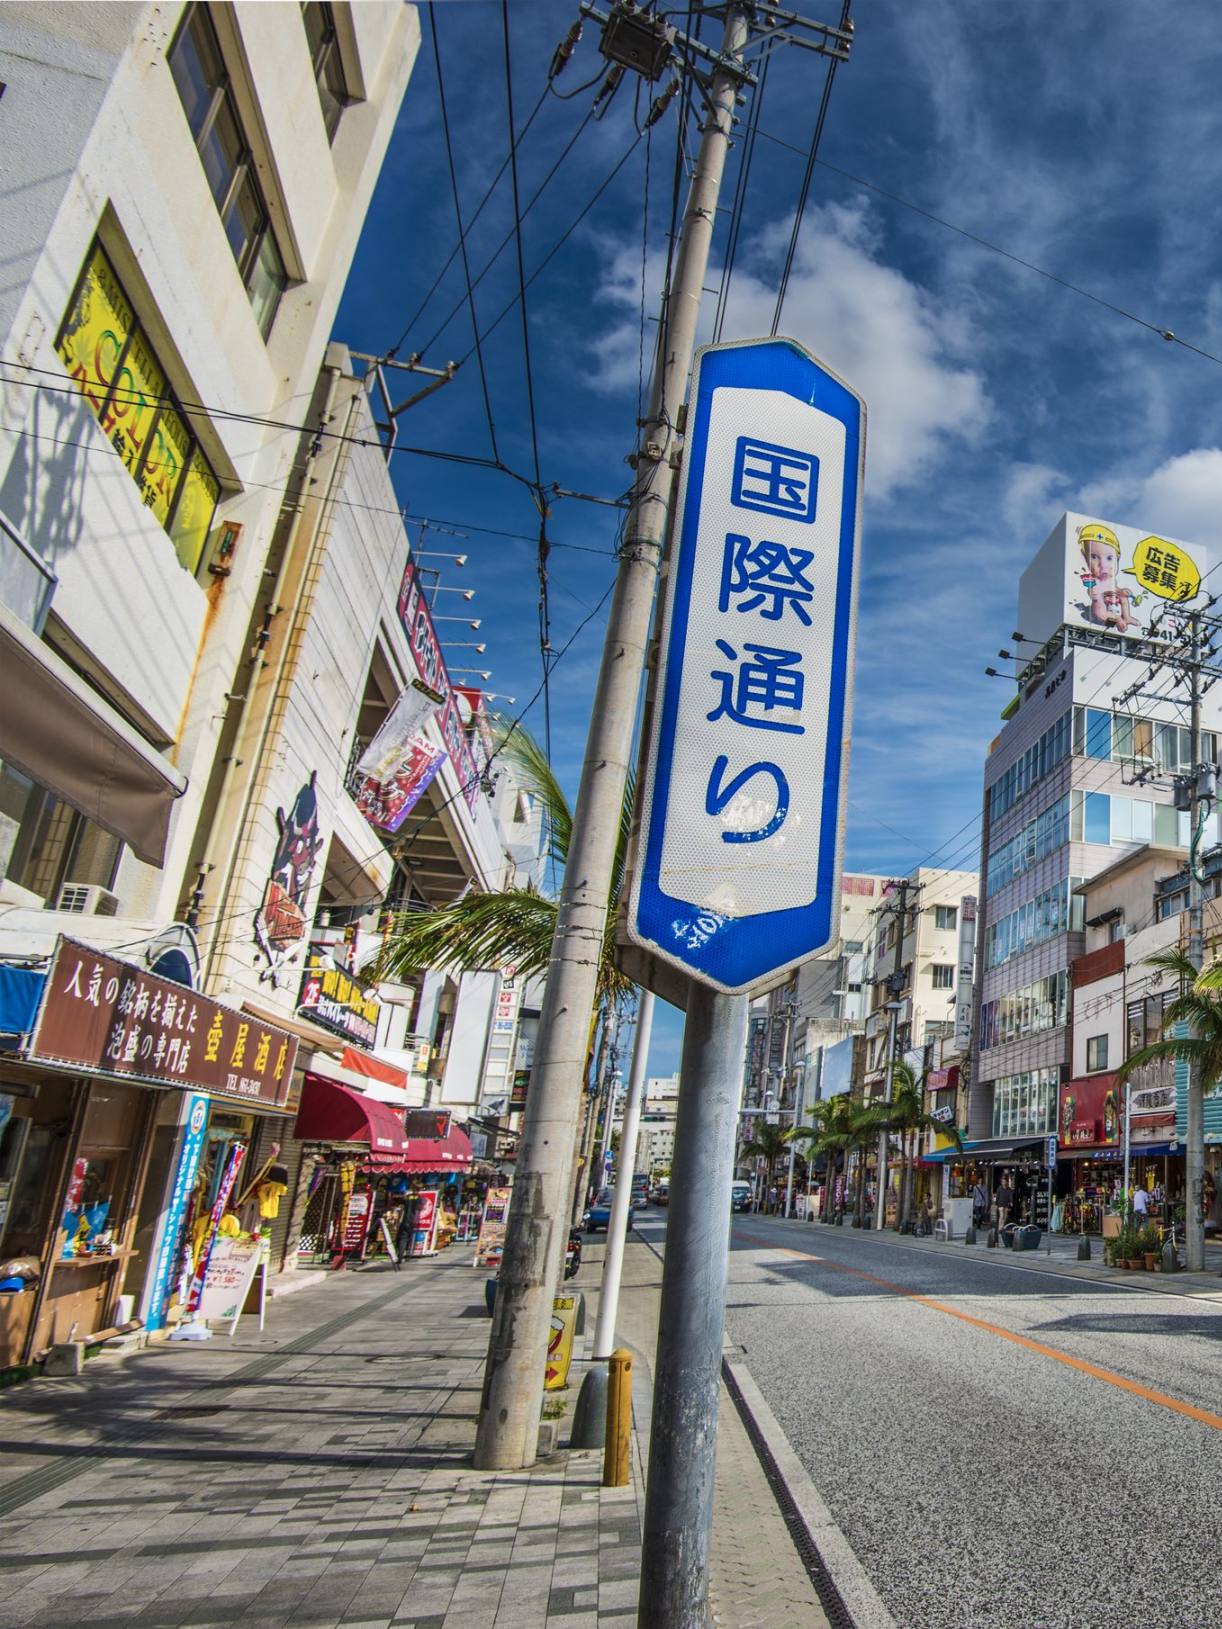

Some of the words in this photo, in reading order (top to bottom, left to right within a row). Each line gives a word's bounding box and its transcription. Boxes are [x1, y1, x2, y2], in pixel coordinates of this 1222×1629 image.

[1144, 546, 1181, 573] 広告
[706, 434, 821, 845] 国際通り
[63, 959, 200, 1034] 人気の銘柄を揃えた
[106, 1021, 193, 1075] 泡盛の専門店
